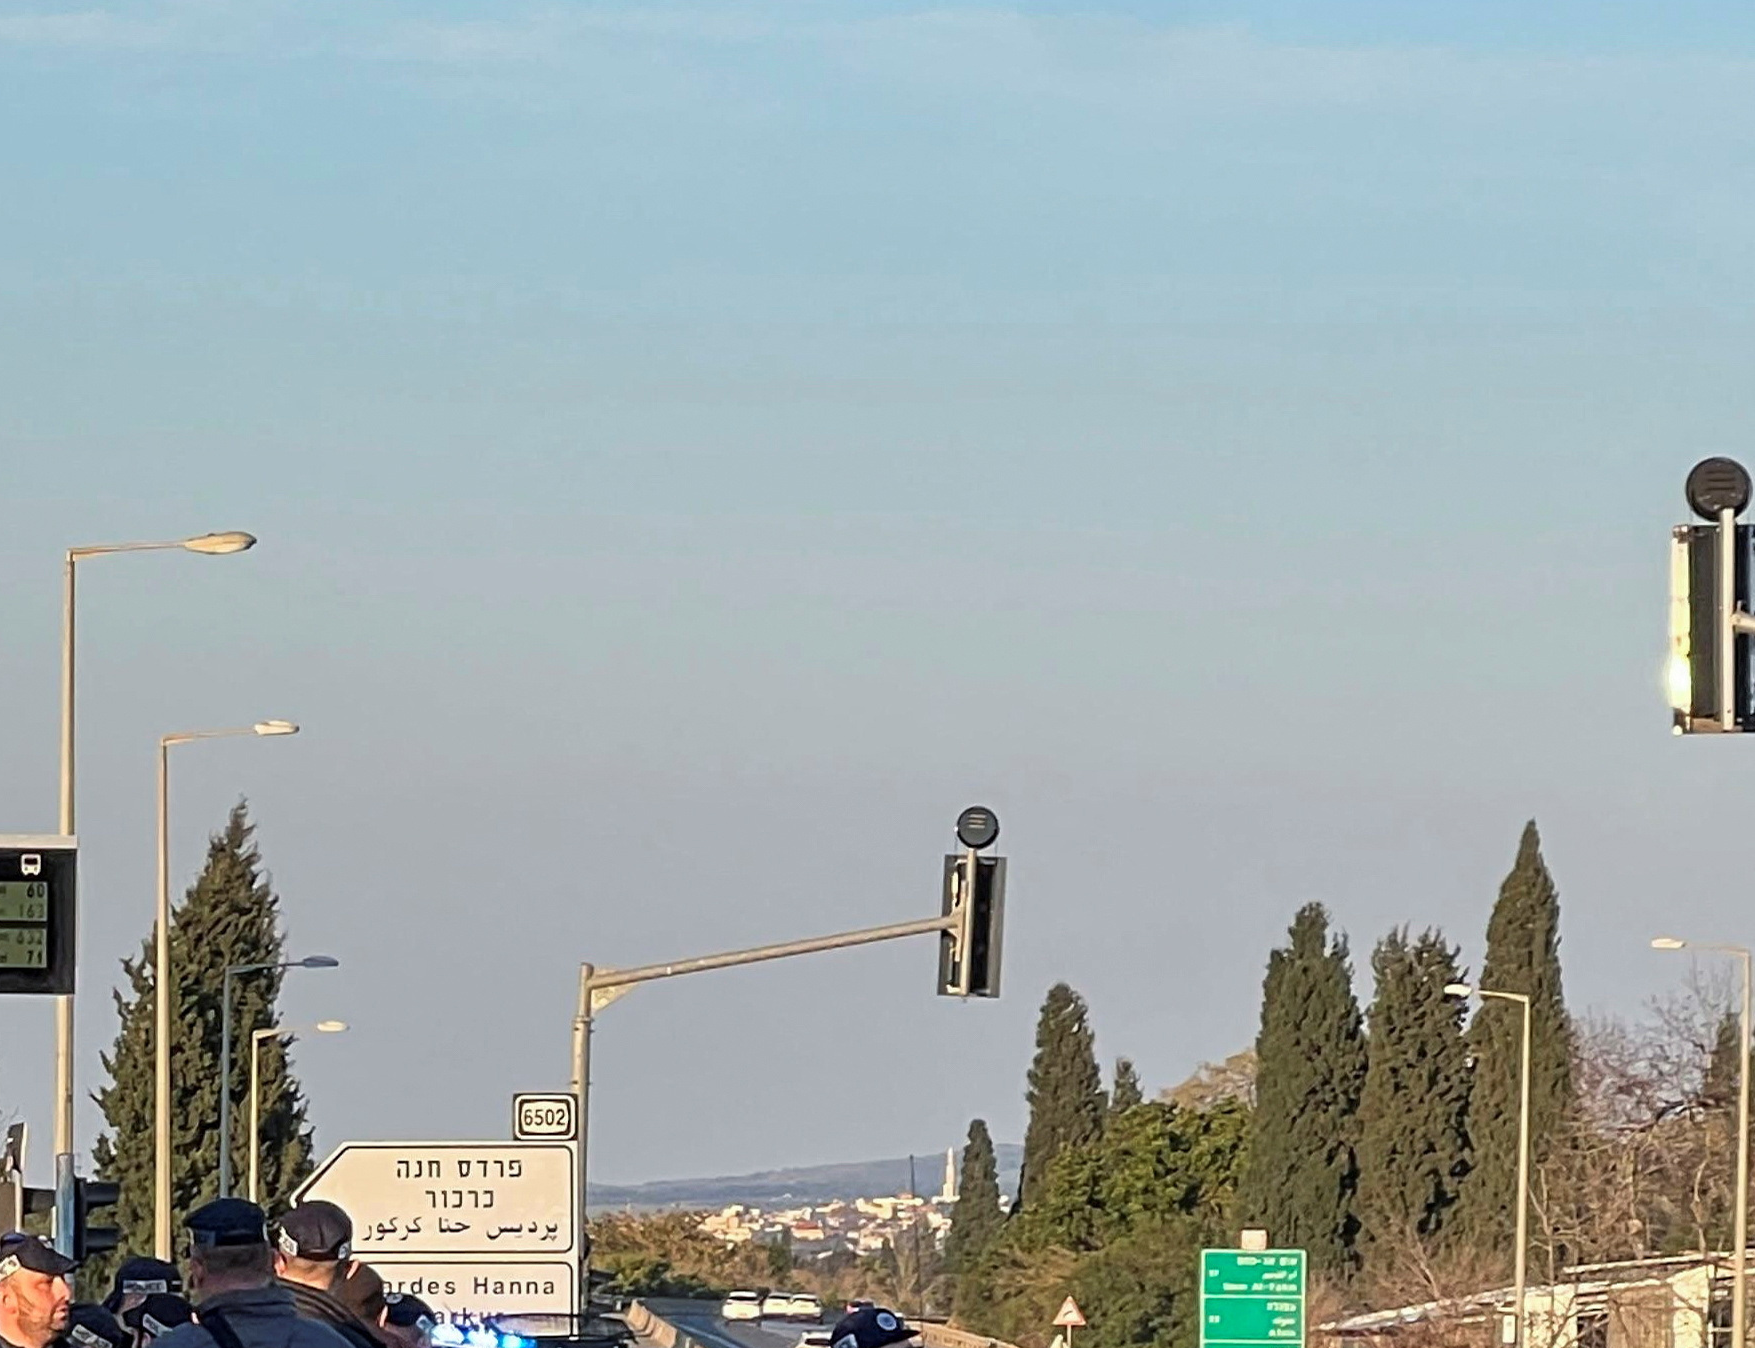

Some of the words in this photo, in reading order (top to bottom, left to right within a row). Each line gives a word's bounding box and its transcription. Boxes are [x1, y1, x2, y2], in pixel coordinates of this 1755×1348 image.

[26, 883, 45, 899] 60
[523, 1108, 567, 1127] 6502
[396, 1160, 442, 1179] חנה
[457, 1159, 522, 1179] פרדס
[425, 1190, 494, 1209] כרכור
[361, 1216, 423, 1242] كركور
[438, 1216, 472, 1234] حنا
[381, 1277, 456, 1295] ardes
[473, 1277, 555, 1295] Hanna
